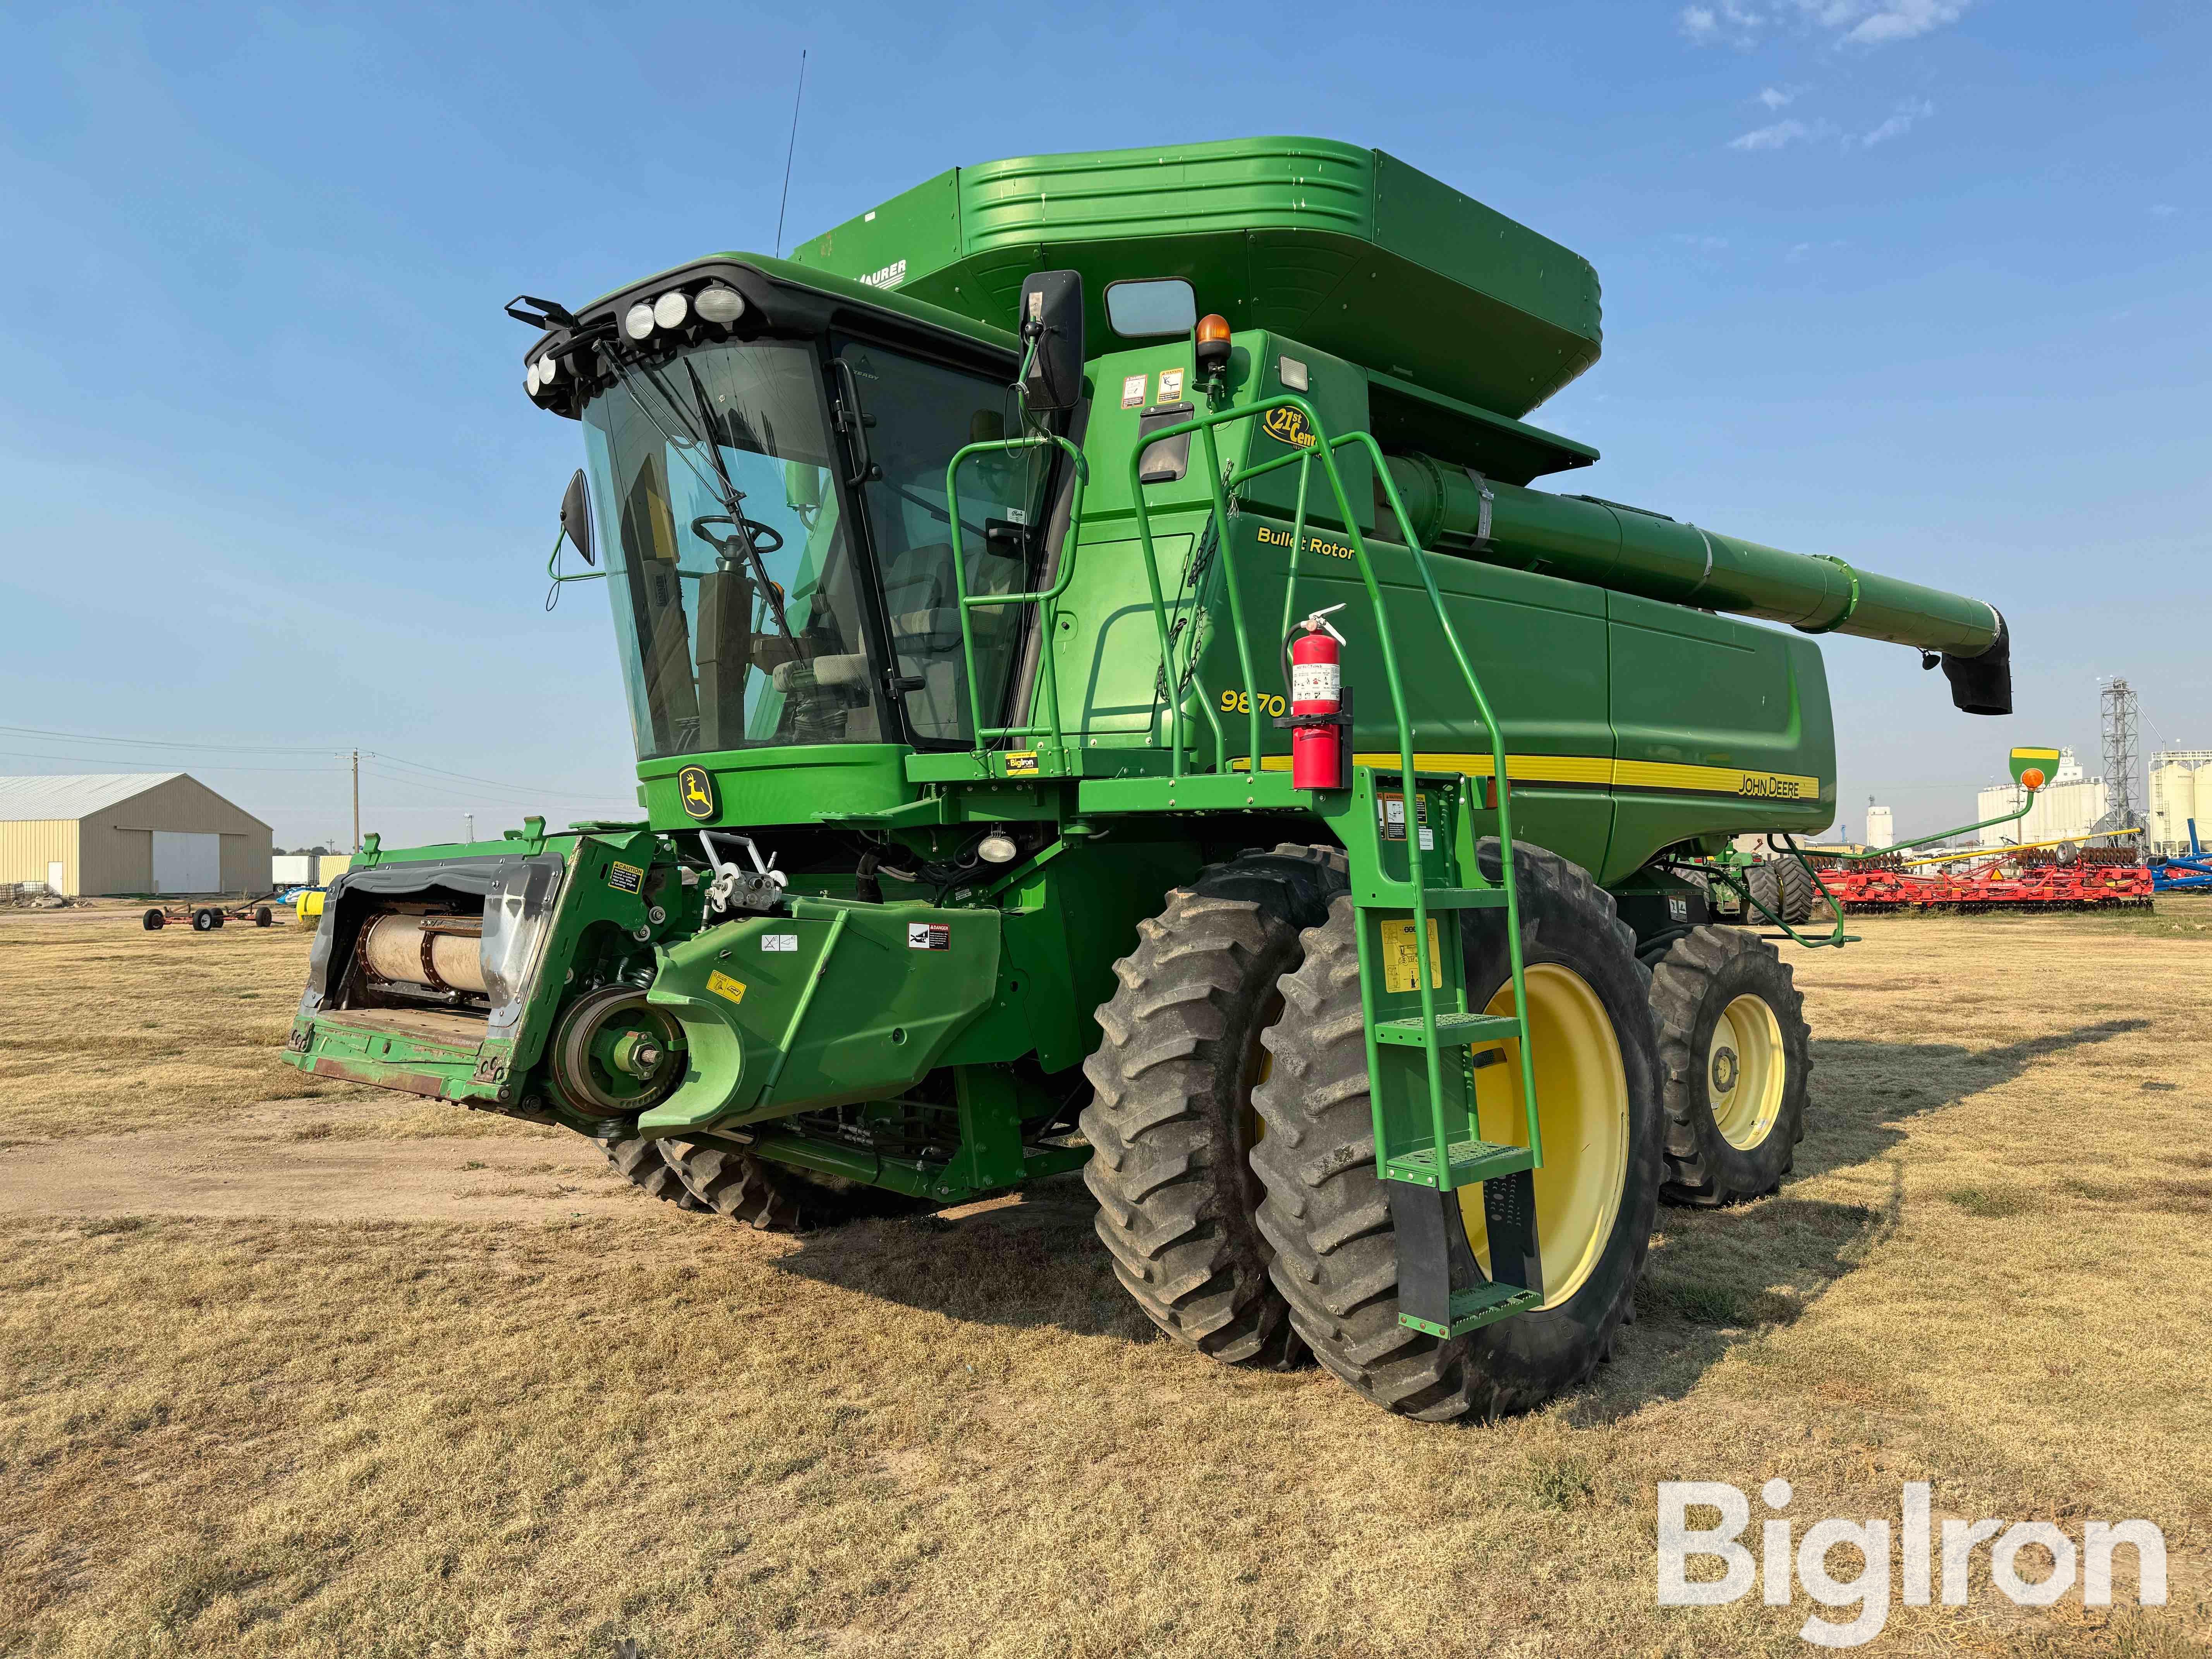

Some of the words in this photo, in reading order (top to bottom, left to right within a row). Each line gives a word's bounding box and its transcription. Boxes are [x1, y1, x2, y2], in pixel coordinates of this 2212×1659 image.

[1272, 408, 1302, 431] 21st
[1290, 422, 1316, 446] Cent
[1310, 538, 1355, 560] Rotor
[1221, 690, 1286, 717] 9870
[1010, 758, 1034, 768] BigIron
[1739, 774, 1767, 795] JOHN
[1769, 777, 1799, 797] DEERE
[619, 864, 642, 874] CAUTION
